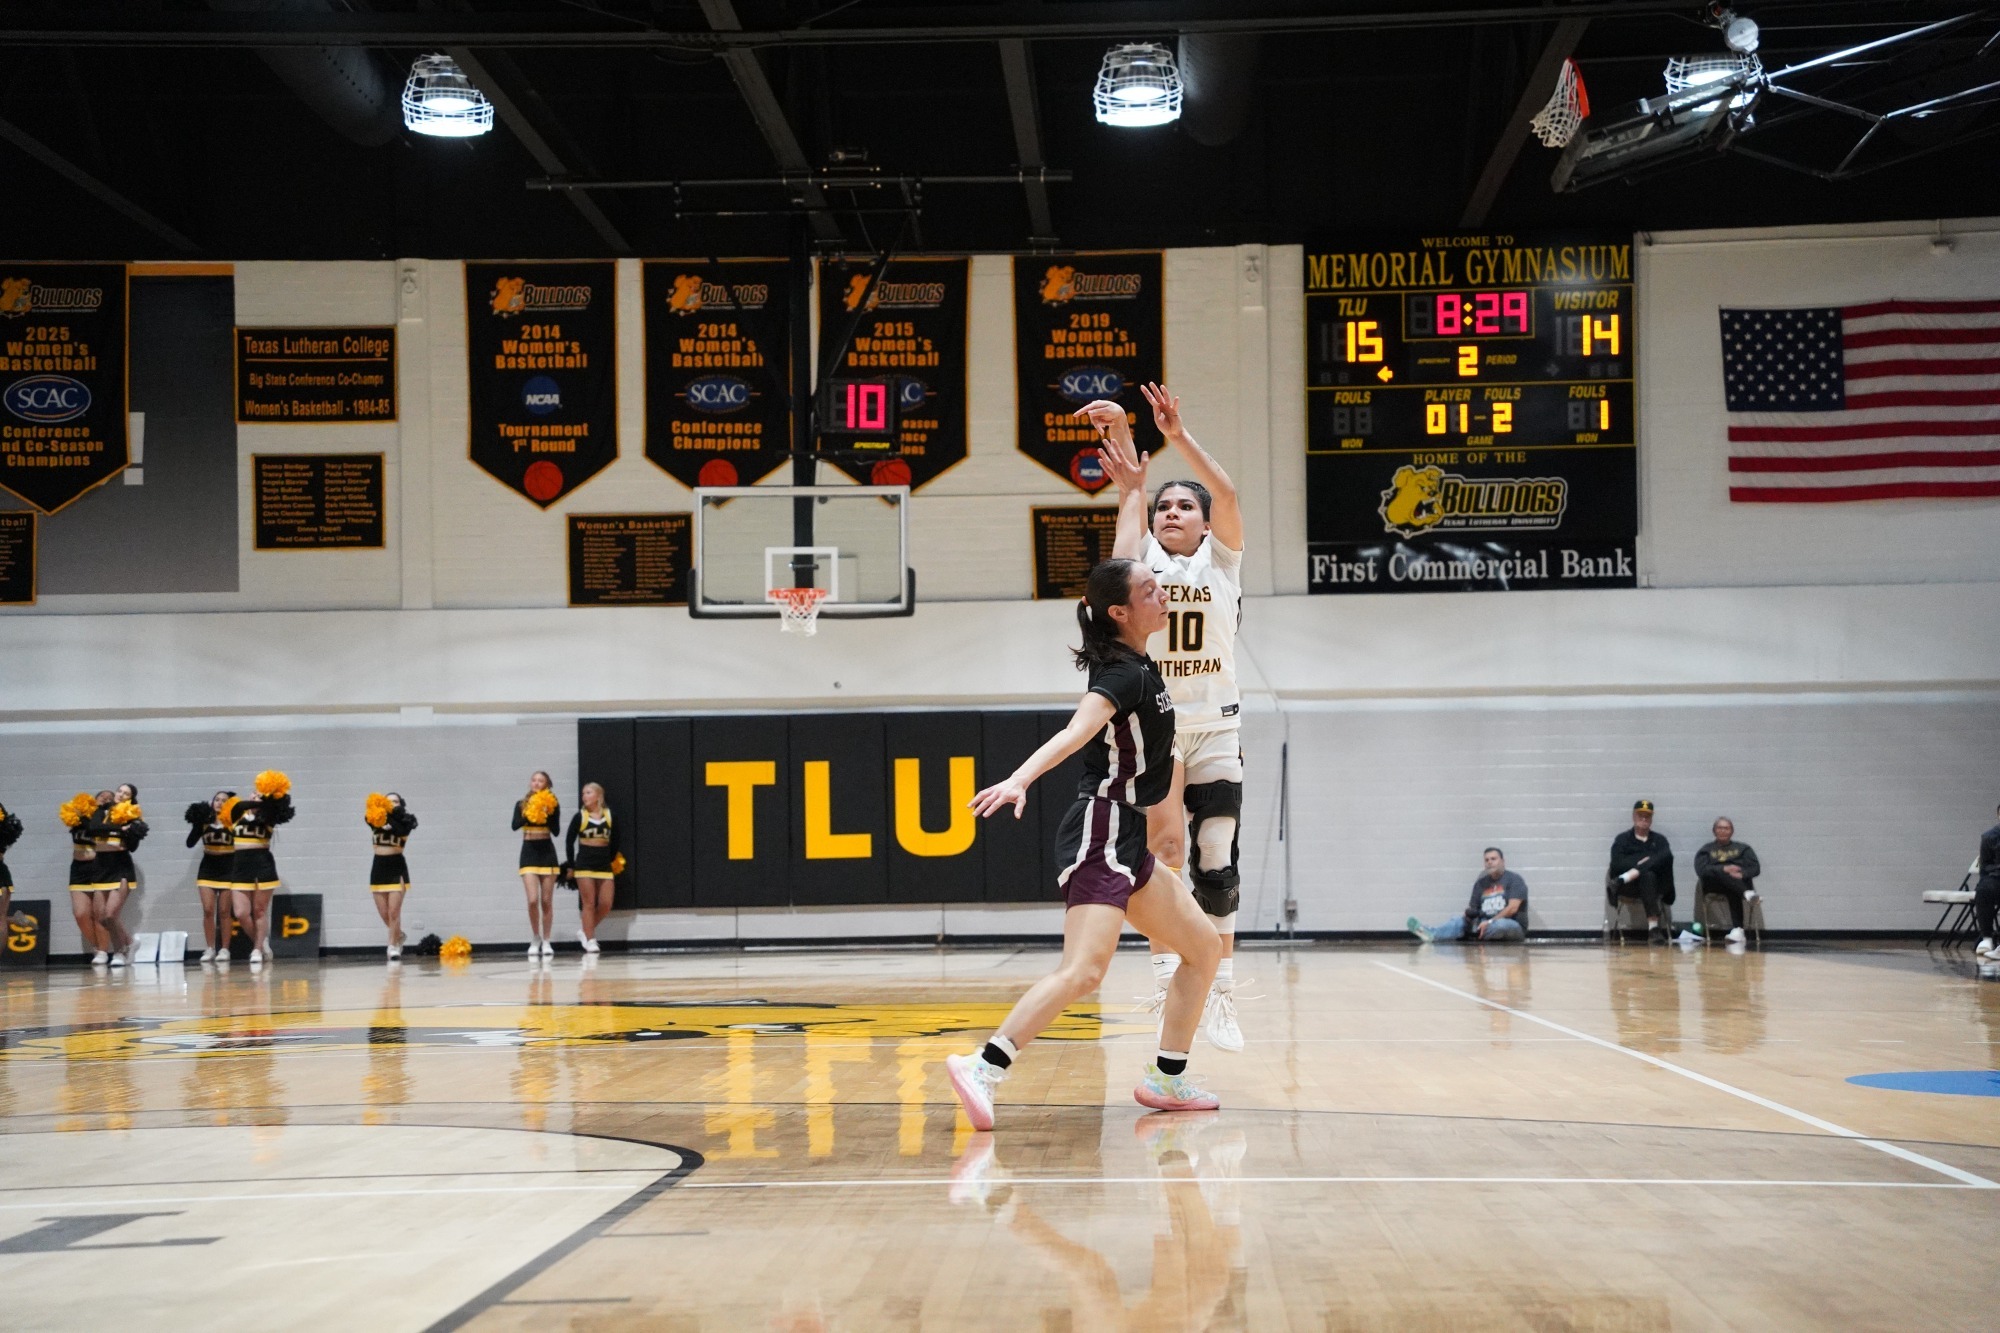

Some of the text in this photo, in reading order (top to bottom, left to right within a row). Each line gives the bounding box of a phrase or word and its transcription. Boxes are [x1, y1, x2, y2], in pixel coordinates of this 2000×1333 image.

[1422, 235, 1514, 248] WELCOME TO
[1308, 245, 1630, 289] MEMORIAL GYMNASIUM
[1338, 298, 1368, 316] TLU
[1554, 290, 1619, 310] VISITOR
[1070, 313, 1110, 328] 2019
[1436, 292, 1528, 335] 8:29
[26, 327, 70, 341] 2025
[521, 325, 560, 339] 2014
[698, 323, 737, 338] 2014
[874, 322, 914, 336] 2015
[1052, 328, 1128, 344] Women's
[1582, 314, 1619, 356] 14
[7, 341, 88, 356] Women's
[244, 336, 389, 357] Texas Lutheran College
[502, 340, 580, 354] Women's
[679, 337, 756, 353] Women's
[855, 337, 932, 352] Women's
[1346, 321, 1383, 362] 15
[1044, 342, 1137, 358] Basketball
[0, 356, 96, 371] Basketball
[495, 354, 588, 369] Basketball
[672, 352, 764, 367] Basketball
[848, 351, 939, 366] Basketball
[1458, 345, 1478, 377] 2
[1485, 354, 1517, 365] PERIOD
[249, 373, 384, 388] Big State Conference Co-Champs
[1063, 374, 1118, 395] SCAC
[17, 387, 79, 409] SCAC
[690, 384, 746, 403] SCAC
[1334, 391, 1372, 404] FOULS
[1424, 387, 1522, 402] PLAYER FOULS
[1569, 385, 1606, 398] FOULS
[526, 394, 560, 405] NCAA
[847, 384, 886, 429] 10
[244, 400, 289, 416] Women's
[292, 399, 344, 416] Basketball
[353, 399, 390, 415] 1984-85
[3, 425, 90, 438] Conference
[498, 423, 589, 437] Tournament
[671, 420, 762, 434] Conference
[673, 435, 761, 451] Champions
[1341, 438, 1364, 448] WON
[1466, 435, 1494, 446] GAME
[1576, 432, 1599, 443] WON
[531, 439, 576, 452] Round
[7, 454, 90, 467] Champions
[1413, 451, 1527, 465] HOME OF THE
[1442, 478, 1565, 516] BULLDOGS
[1311, 548, 1633, 583] First Commercial Bank
[1168, 611, 1205, 652] 10
[705, 756, 976, 860] TLU
